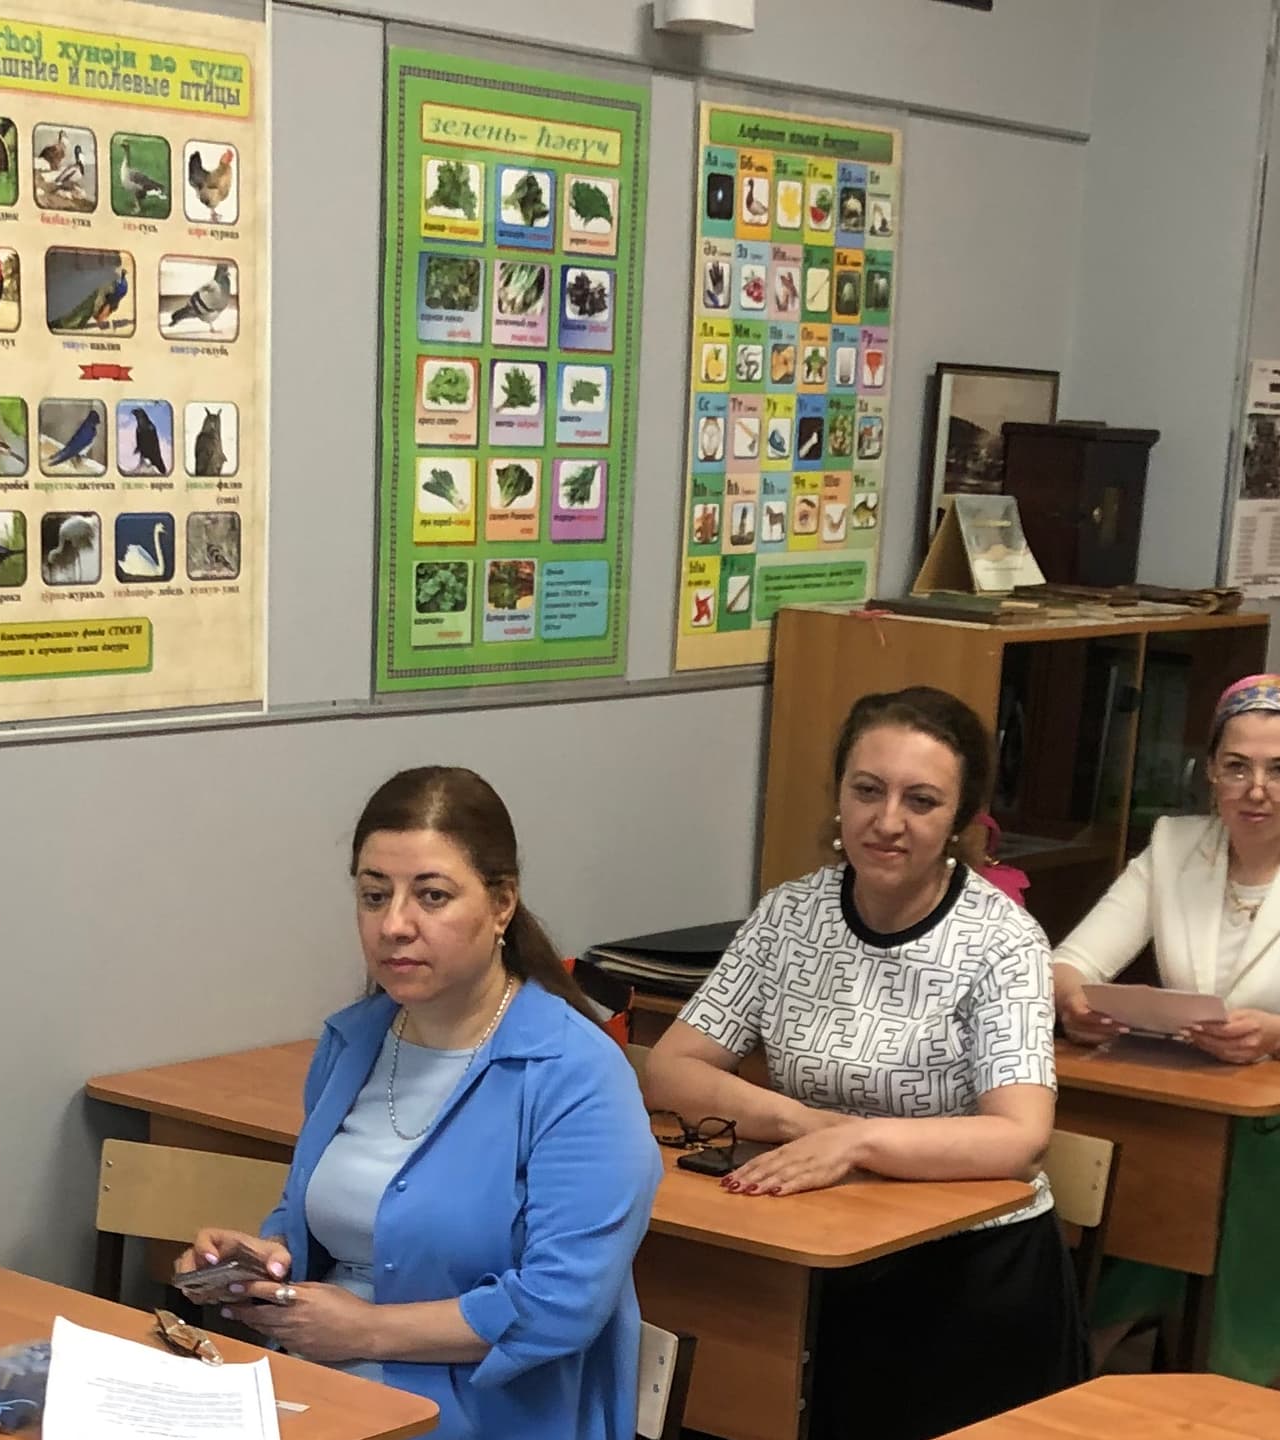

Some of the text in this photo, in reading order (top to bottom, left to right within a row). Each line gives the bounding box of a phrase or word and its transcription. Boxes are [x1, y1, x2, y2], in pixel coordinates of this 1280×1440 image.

[69, 65, 80, 86] и
[85, 68, 170, 97] полевые
[181, 81, 240, 109] птицы
